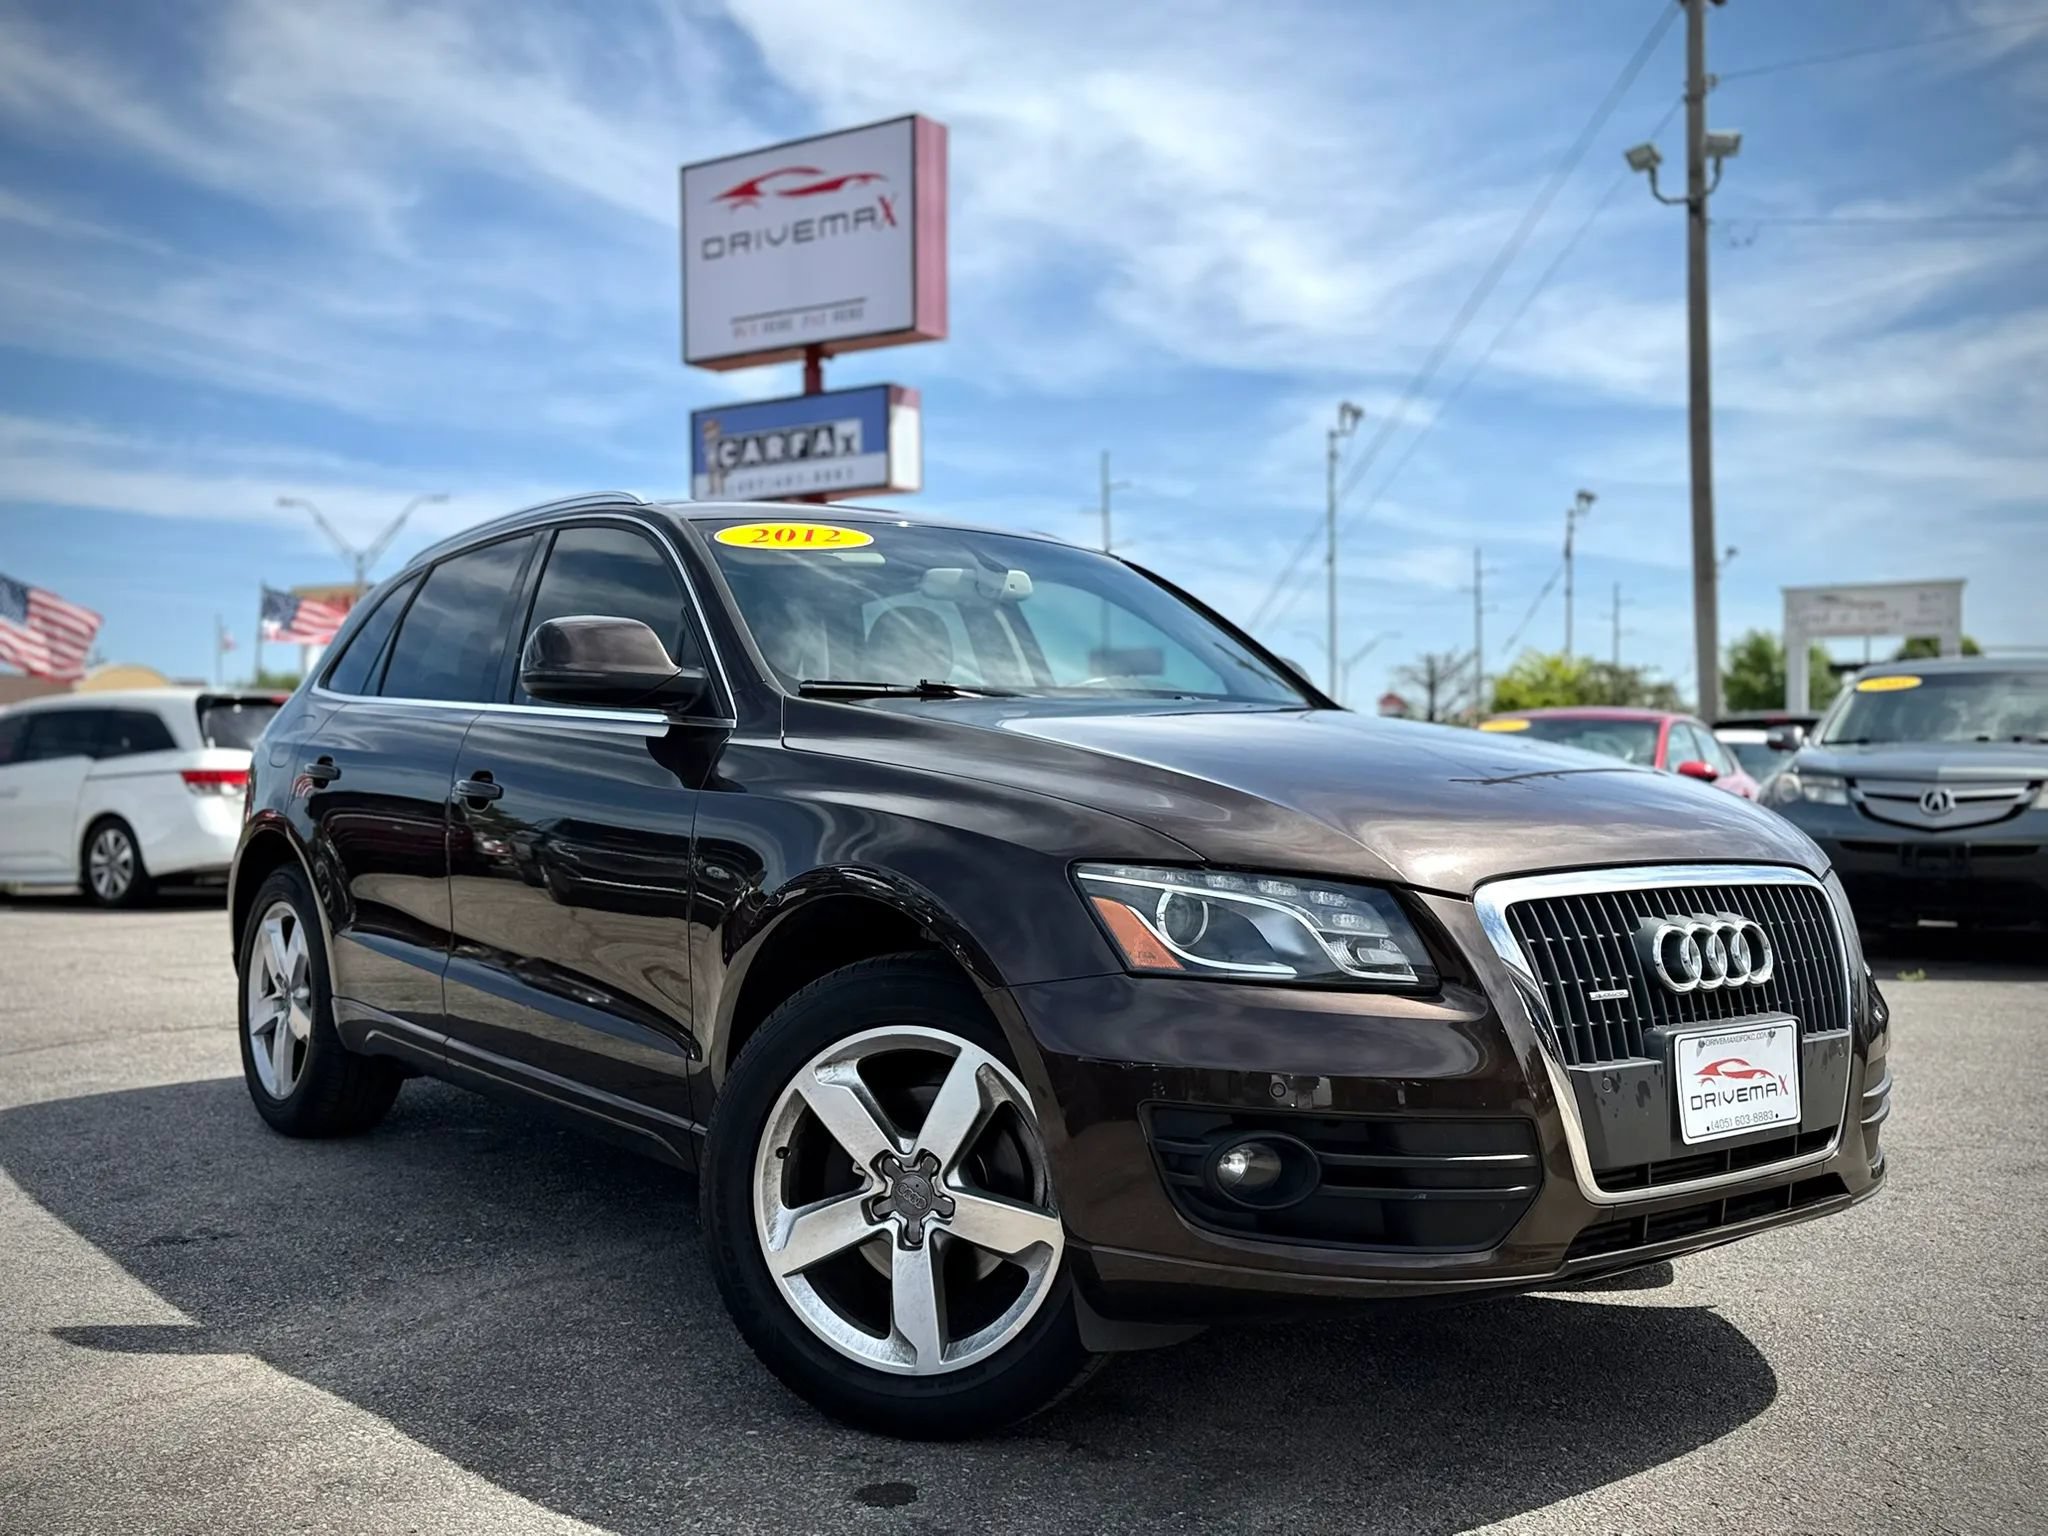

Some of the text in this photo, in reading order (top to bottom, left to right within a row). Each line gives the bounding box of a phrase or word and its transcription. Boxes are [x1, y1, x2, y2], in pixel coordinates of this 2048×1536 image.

[701, 193, 897, 261] DRIVEMAX
[720, 427, 856, 467] CARFAX
[751, 528, 842, 543] 2012
[1690, 1073, 1789, 1110] DRIVEMAX
[1711, 1110, 1774, 1131] (405) 603-8883
